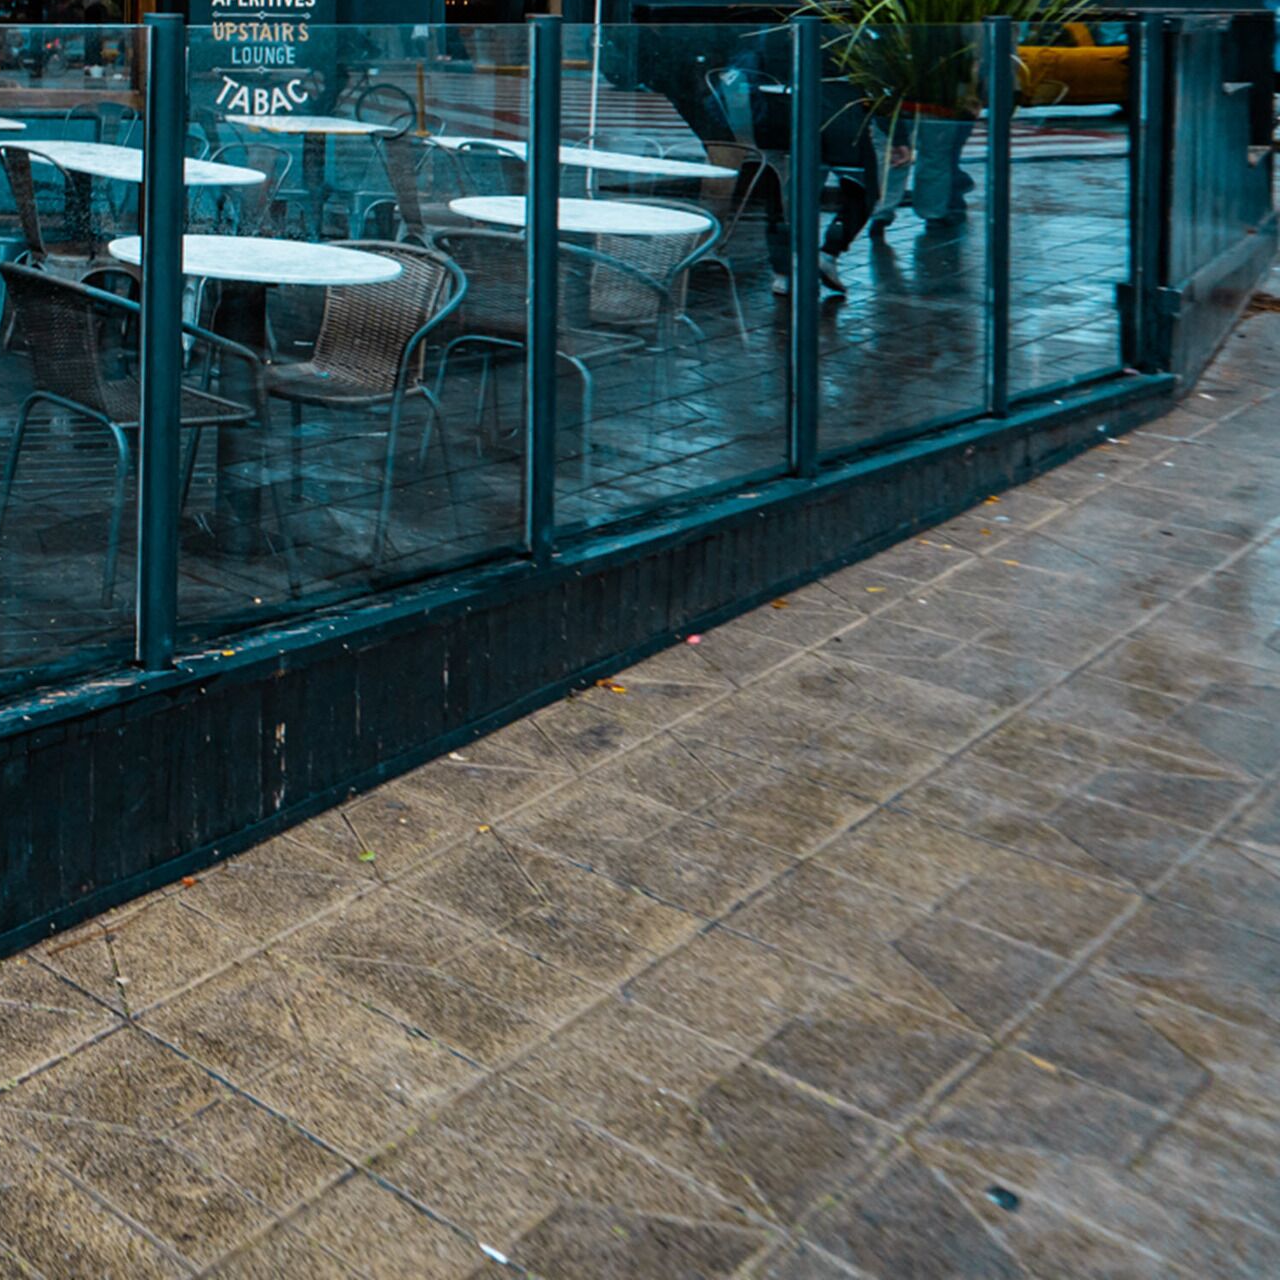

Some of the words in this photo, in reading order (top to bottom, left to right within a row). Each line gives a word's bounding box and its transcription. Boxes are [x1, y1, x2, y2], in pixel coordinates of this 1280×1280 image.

[211, 21, 310, 42] UPSTAIRS
[230, 45, 296, 65] LOUNGE
[215, 75, 309, 116] TABAC
